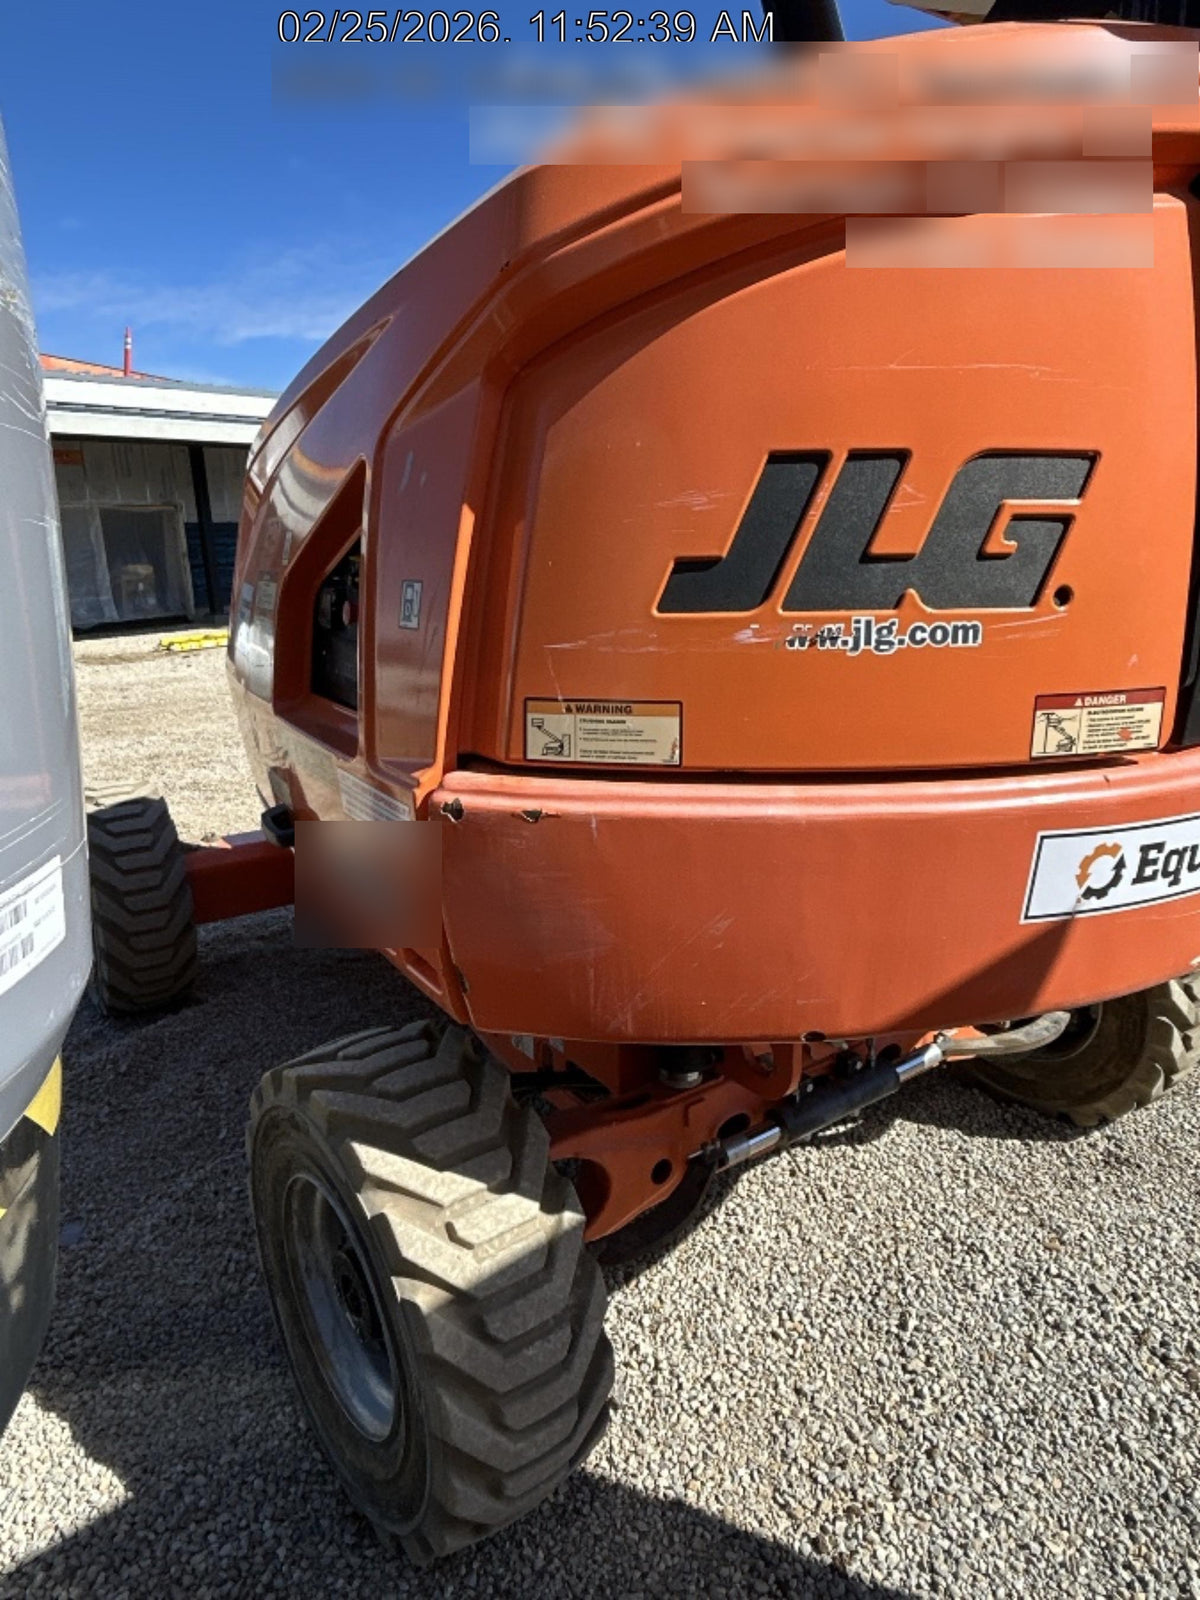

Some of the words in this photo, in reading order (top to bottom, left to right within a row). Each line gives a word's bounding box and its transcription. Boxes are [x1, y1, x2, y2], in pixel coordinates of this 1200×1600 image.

[783, 616, 982, 656] ww.jlg.com
[1084, 694, 1127, 706] DANGER
[575, 703, 633, 714] WARNING
